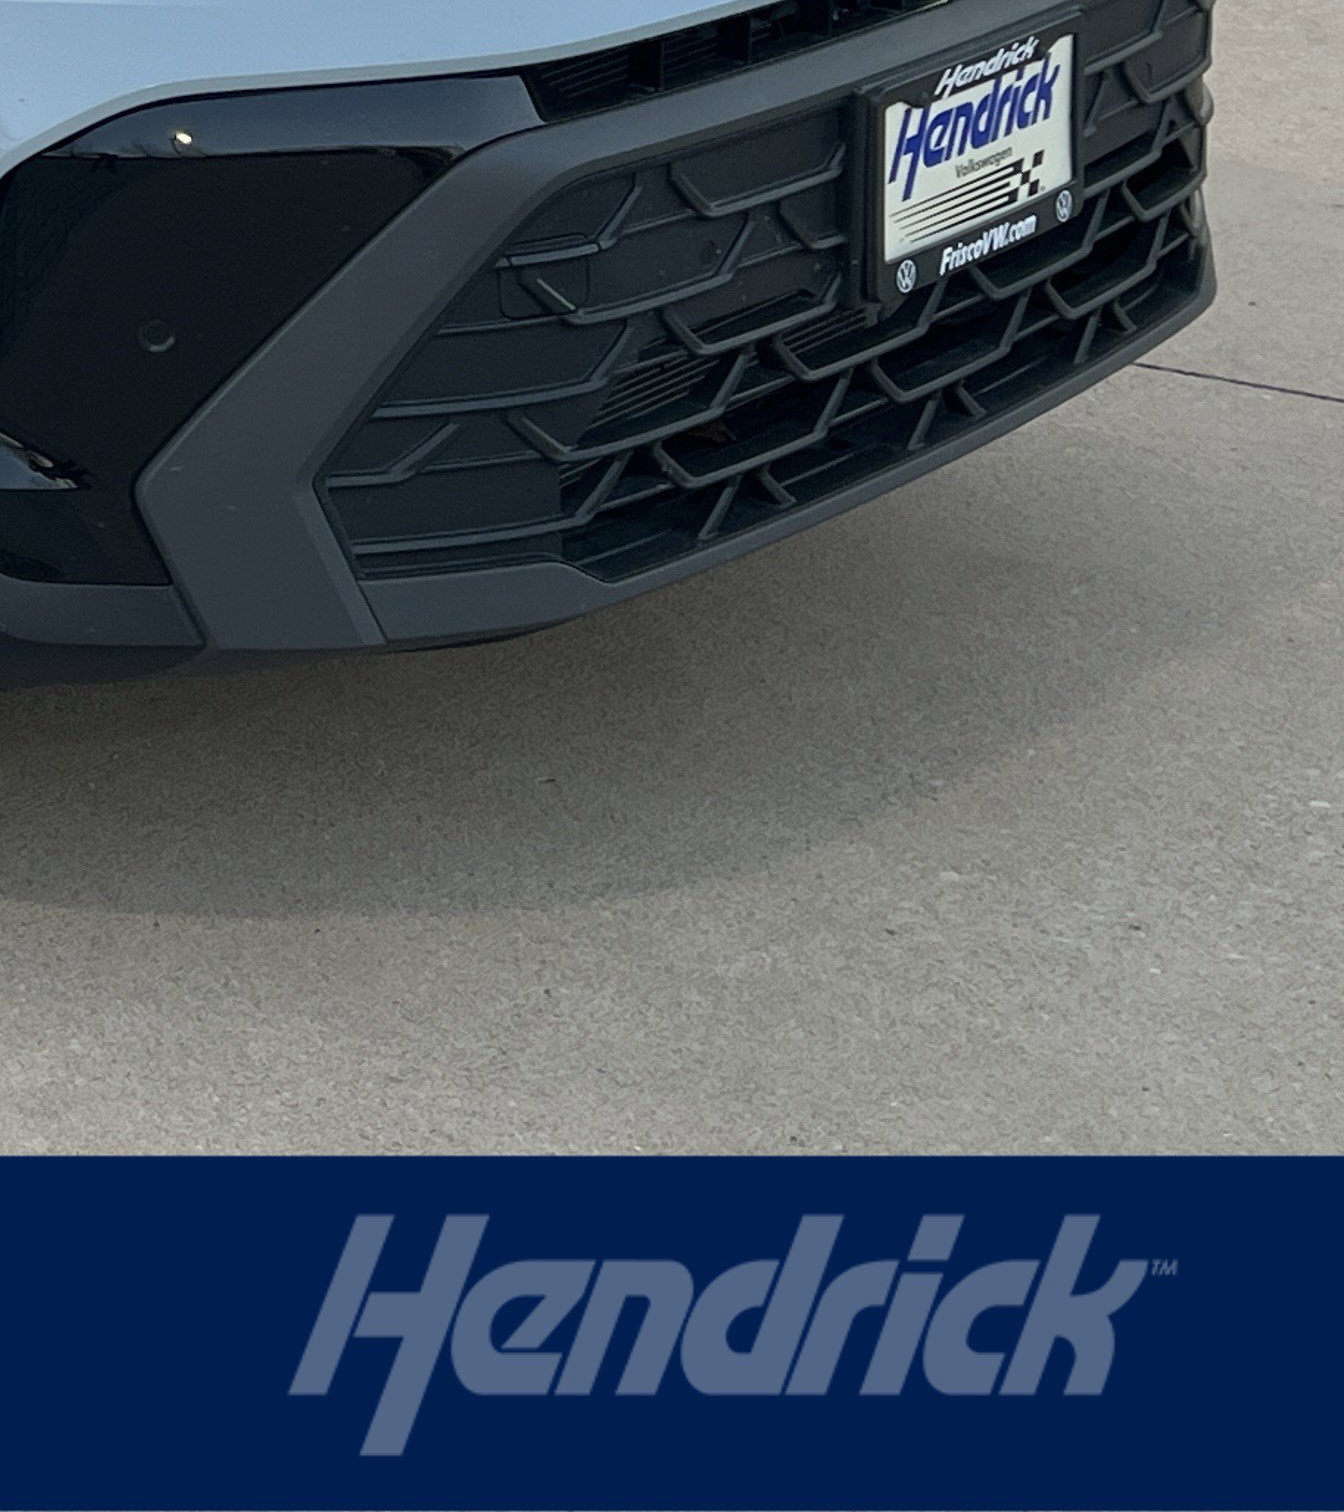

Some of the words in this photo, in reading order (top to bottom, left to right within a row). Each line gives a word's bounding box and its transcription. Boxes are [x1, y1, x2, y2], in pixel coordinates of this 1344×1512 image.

[934, 37, 1039, 100] Hendrick
[887, 42, 1060, 202] Hendrick
[955, 146, 1013, 179] Volkswagen
[939, 215, 1037, 276] FriscoVW.com
